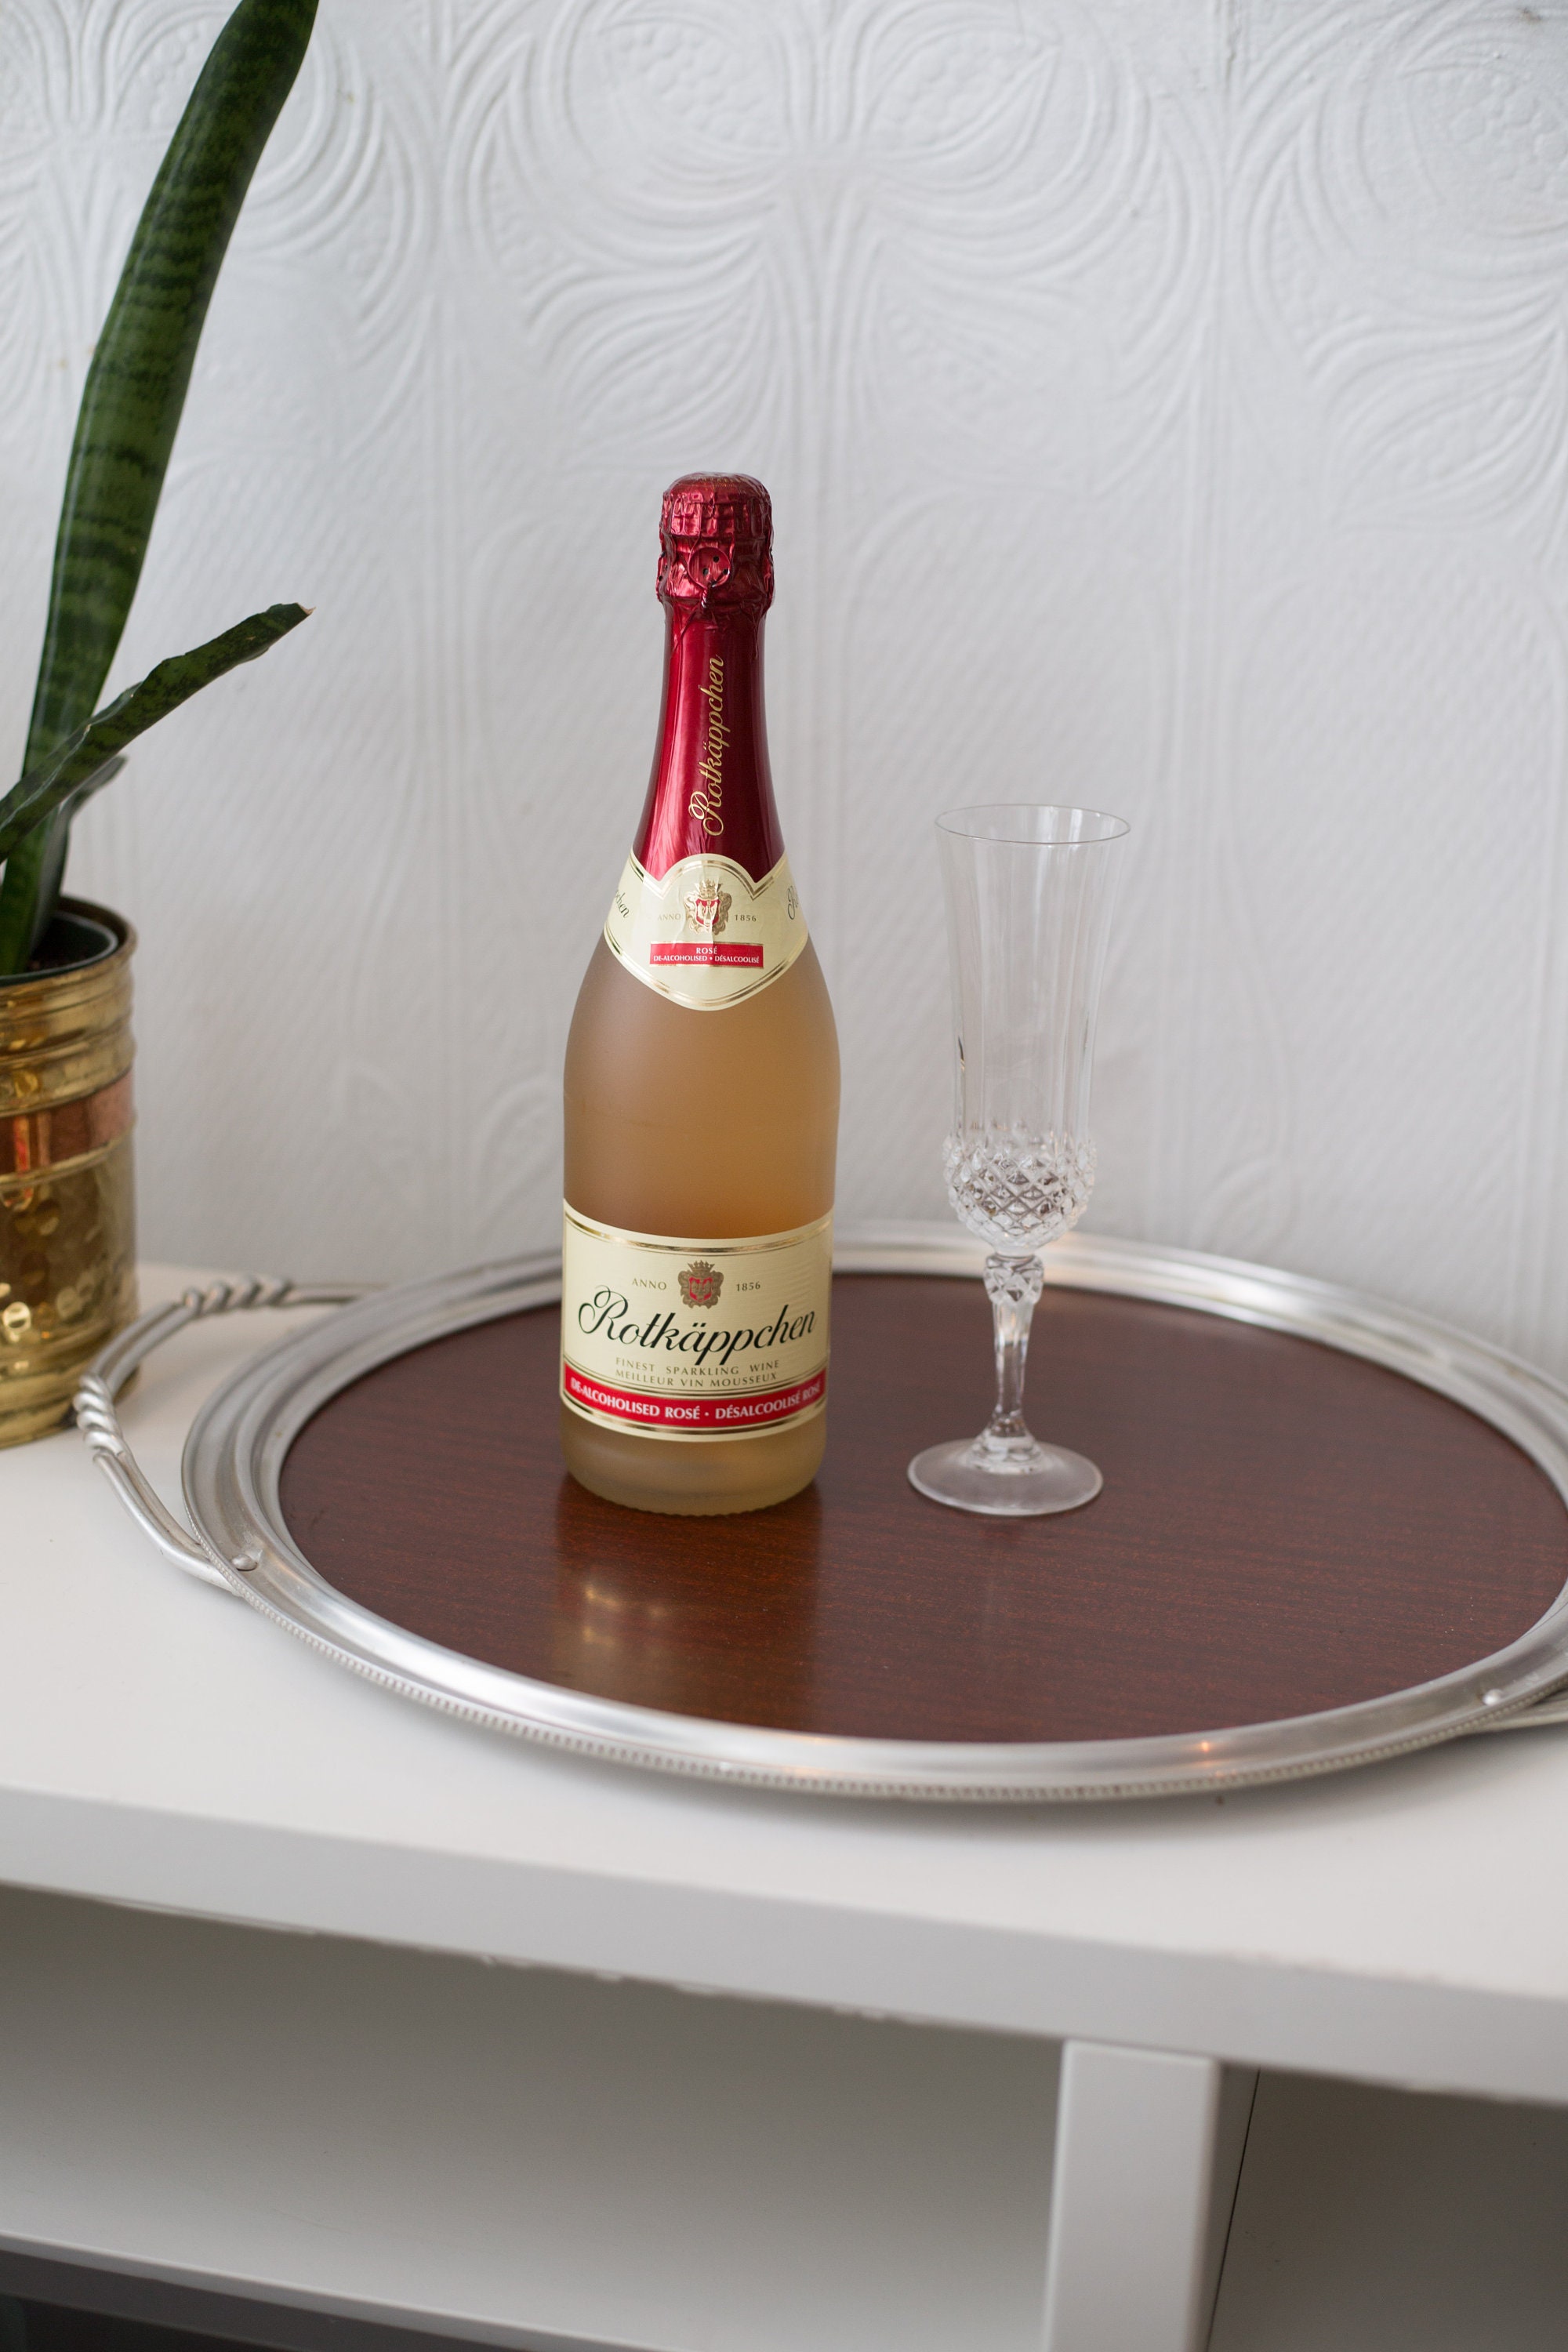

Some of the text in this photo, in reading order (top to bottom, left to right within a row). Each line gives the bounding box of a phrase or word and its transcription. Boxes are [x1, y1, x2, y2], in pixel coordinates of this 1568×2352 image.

[688, 655, 731, 836] Rotkäppchen
[657, 913, 757, 923] ANNO 1856
[695, 946, 718, 955] ROSÉ
[714, 953, 760, 964] DÉSALCOOLISÉ
[632, 1277, 761, 1292] ANNO 1856
[578, 1284, 815, 1366] Rotkäppchen
[616, 1357, 780, 1376] FINEST SPARKLING WINE
[615, 1370, 777, 1388] MEILLEUR VIN MOUSSEUX
[570, 1377, 660, 1417] DE-ALCOHOLISED
[665, 1405, 700, 1420] ROSÉ
[715, 1388, 800, 1420] DÉSALCOOLISÉ
